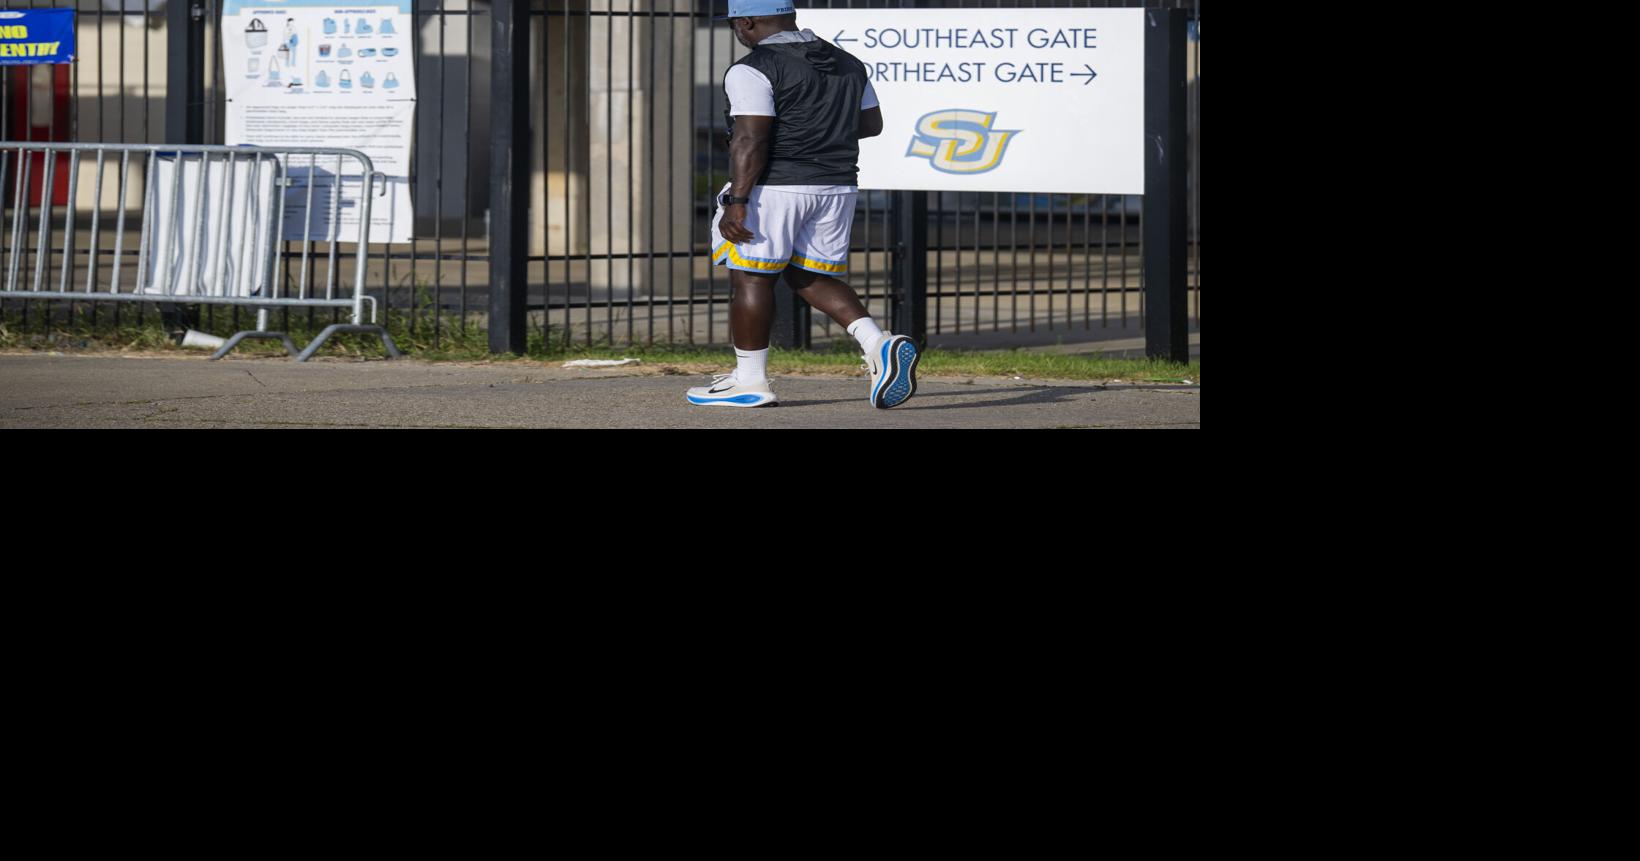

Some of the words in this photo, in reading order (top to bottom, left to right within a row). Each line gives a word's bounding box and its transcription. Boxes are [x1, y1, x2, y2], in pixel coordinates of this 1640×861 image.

[0, 25, 28, 39] NO
[864, 28, 1018, 49] SOUTHEAST
[1027, 28, 1097, 49] GATE
[0, 41, 61, 57] ENTRY
[994, 62, 1064, 82] GATE
[905, 108, 1025, 175] SU
